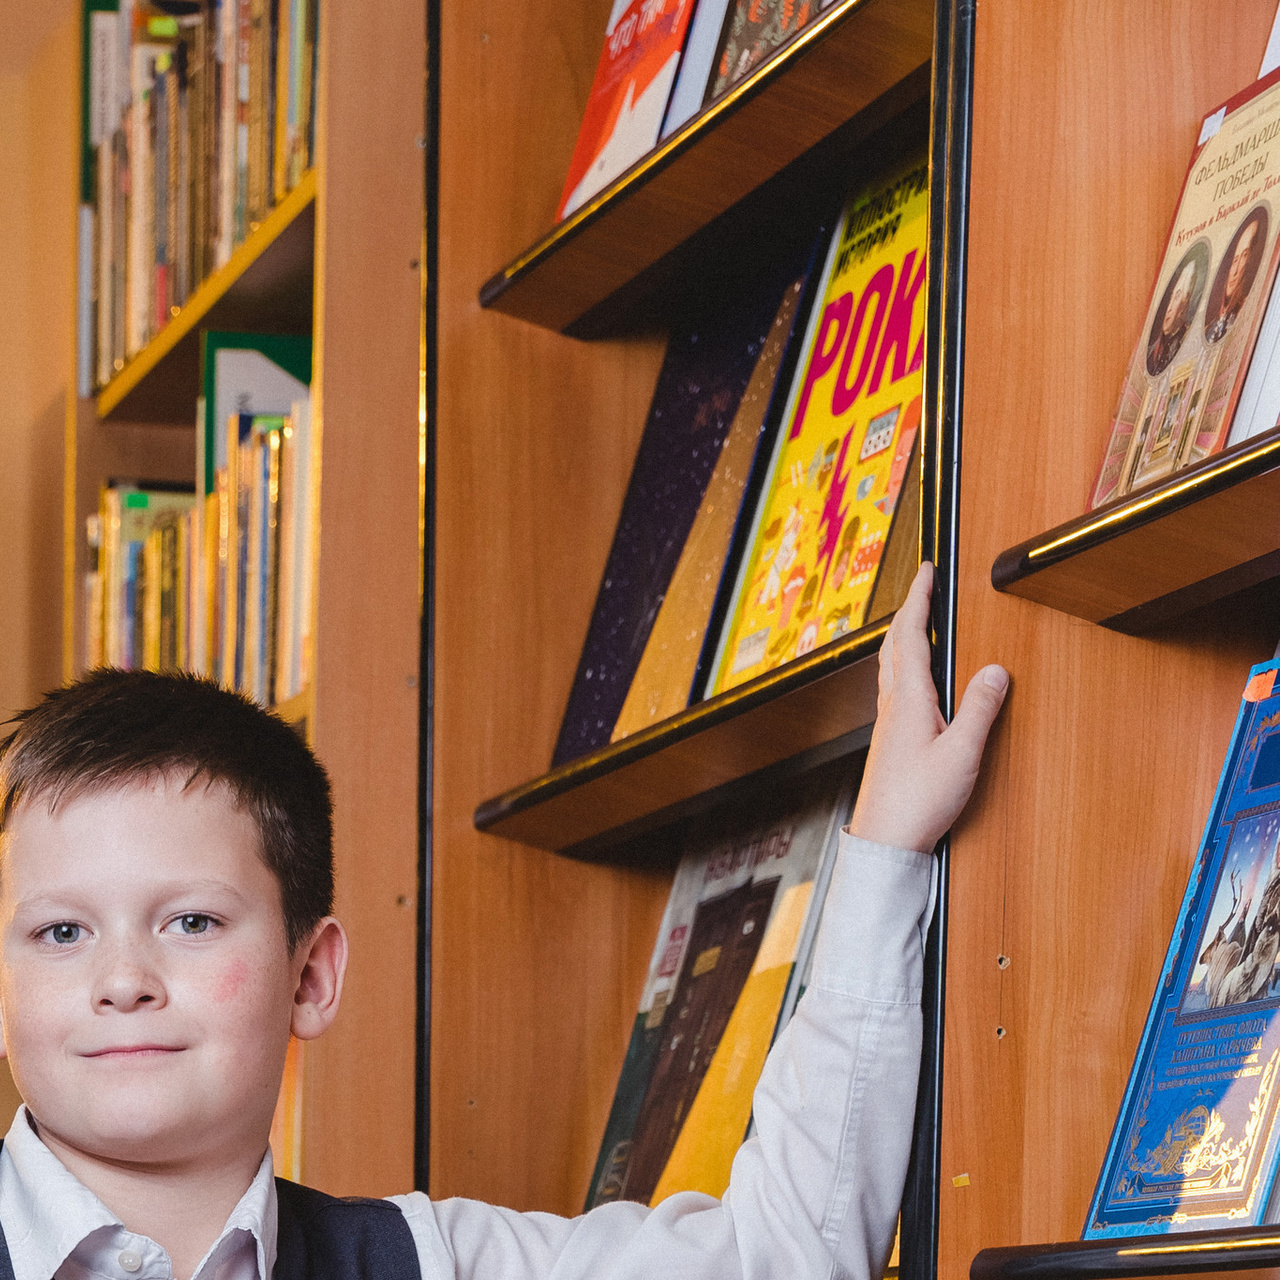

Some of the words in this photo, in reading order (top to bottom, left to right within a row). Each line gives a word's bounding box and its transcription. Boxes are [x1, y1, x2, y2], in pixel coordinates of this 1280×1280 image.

[1213, 152, 1269, 202] ПОБЕДЫ
[1175, 221, 1207, 247] Кутузов
[1215, 190, 1251, 223] Барклай
[788, 247, 927, 442] РОК
[1171, 1044, 1216, 1064] КАПИТАНА
